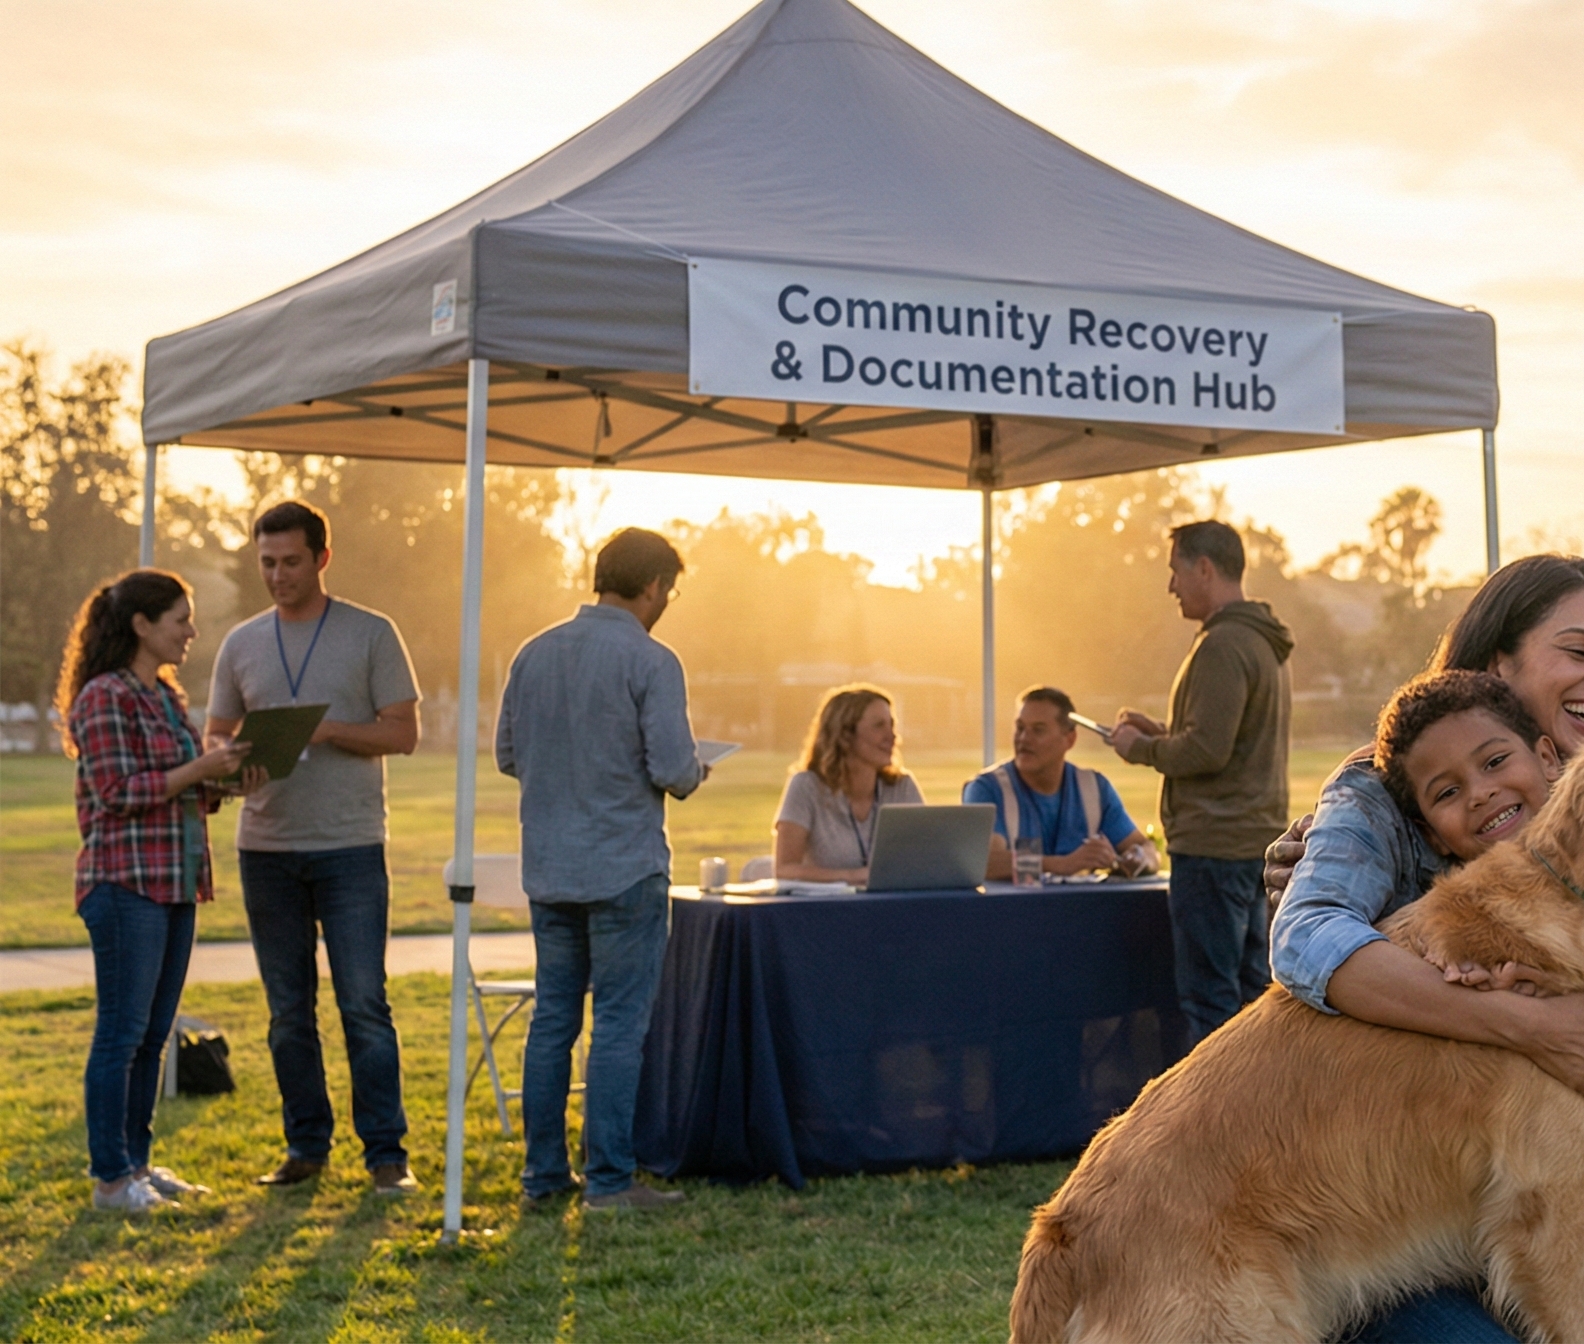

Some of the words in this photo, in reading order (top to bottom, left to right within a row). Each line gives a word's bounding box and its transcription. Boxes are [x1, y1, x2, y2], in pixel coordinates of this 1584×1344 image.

[777, 284, 1052, 351] Community
[1069, 307, 1268, 368] Recovery
[770, 340, 803, 381] &
[822, 344, 1176, 406] Documentation
[1193, 371, 1277, 412] Hub
